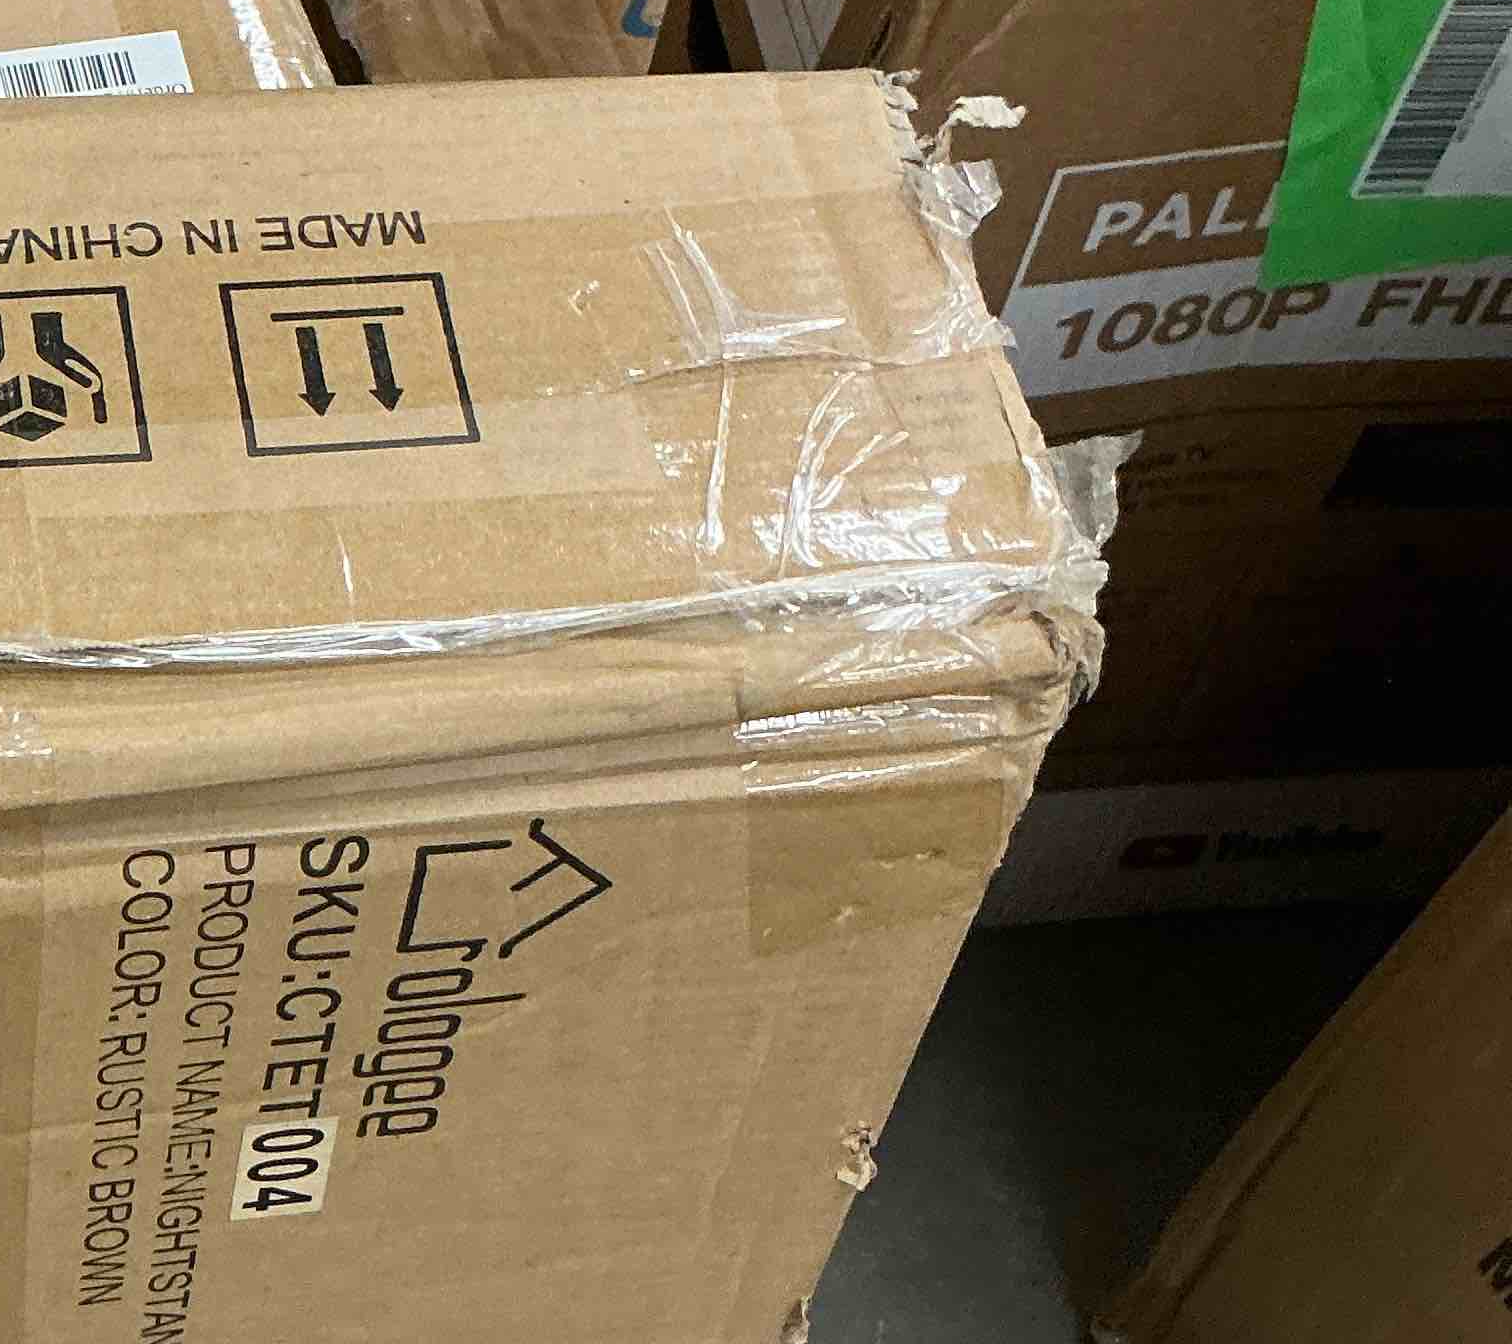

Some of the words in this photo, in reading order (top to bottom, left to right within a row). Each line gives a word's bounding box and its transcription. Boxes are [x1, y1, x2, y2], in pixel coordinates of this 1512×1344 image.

[184, 214, 245, 257] IN
[256, 208, 425, 253] MADE
[1055, 284, 1332, 361] 1080P
[108, 848, 176, 1023] COLOR:
[182, 842, 257, 1047] PRODUCT
[89, 1030, 149, 1171] RUSTIC
[76, 1176, 137, 1308] BROWN
